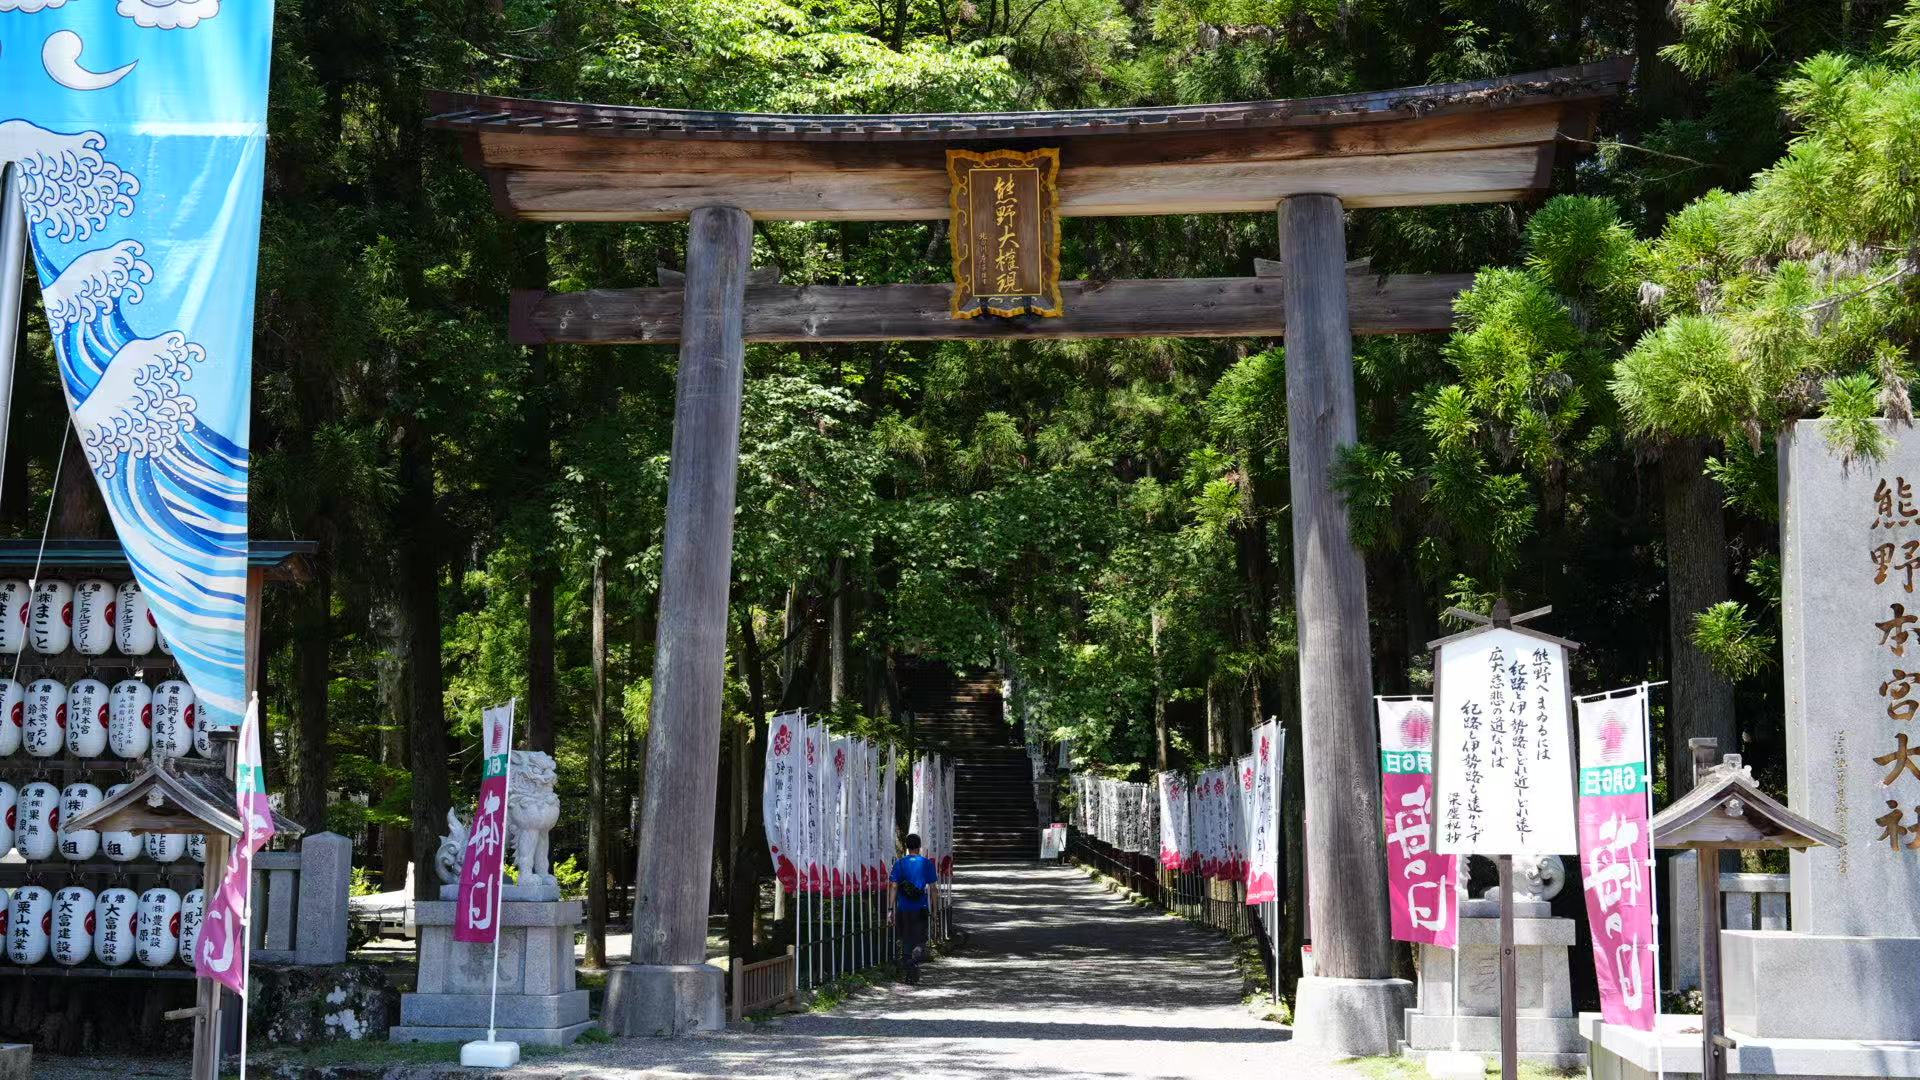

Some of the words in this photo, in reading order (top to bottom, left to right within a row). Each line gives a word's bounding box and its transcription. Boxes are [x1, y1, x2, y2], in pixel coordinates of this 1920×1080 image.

[1532, 647, 1552, 761] 熊野へまゐるには
[1869, 477, 1920, 852] 熊野本宮大社
[69, 699, 80, 752] とりいの店
[81, 695, 92, 735] 熊野本宮
[166, 695, 179, 751] 熊野もうで餅
[1488, 646, 1509, 769] 広大慈悲の道なれば
